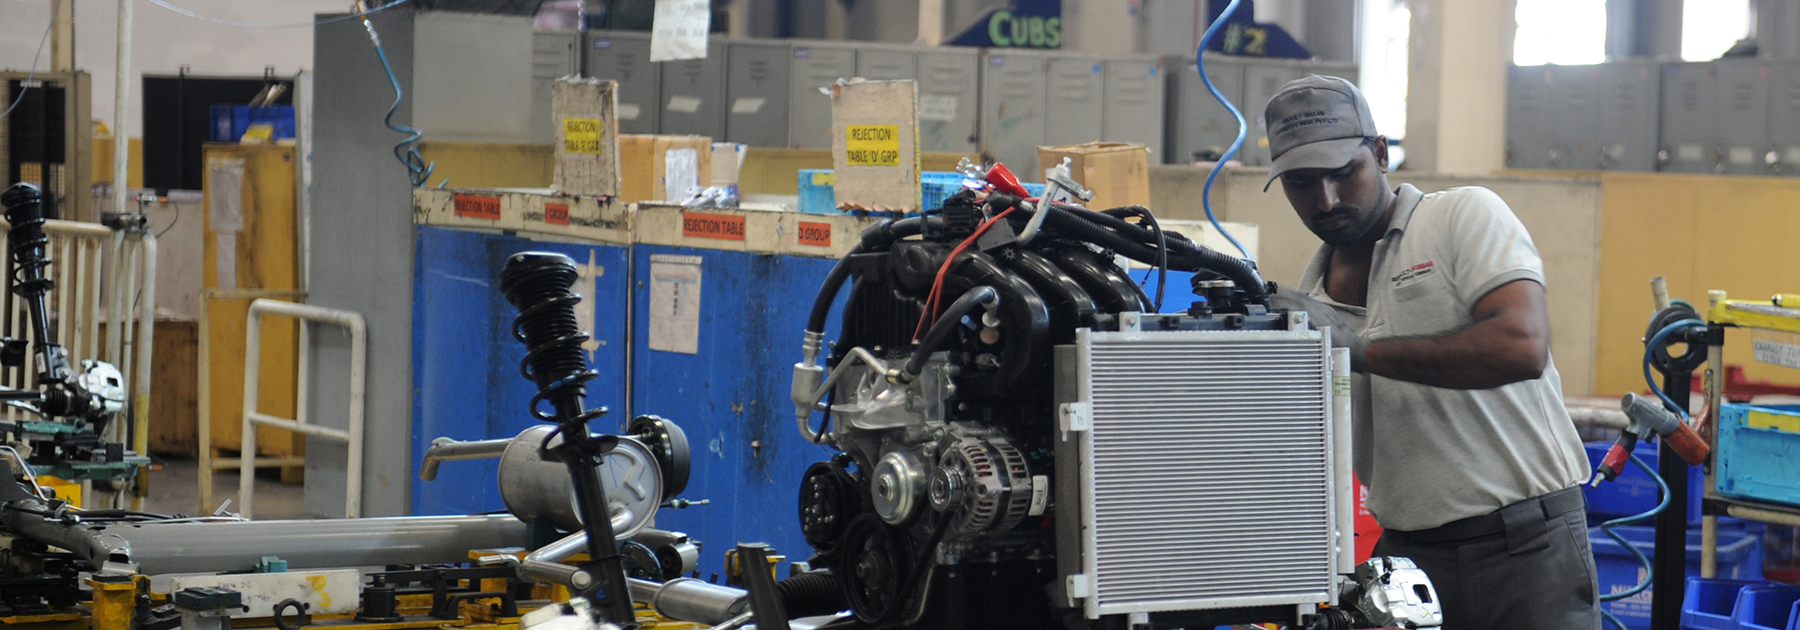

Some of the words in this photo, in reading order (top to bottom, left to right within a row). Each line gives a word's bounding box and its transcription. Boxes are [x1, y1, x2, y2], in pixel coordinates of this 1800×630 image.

[988, 10, 1060, 48] CUBS
[567, 121, 596, 133] REJECTION
[852, 128, 891, 141] REJECTION
[847, 150, 868, 163] TABLE
[881, 150, 898, 163] GRP
[454, 198, 482, 213] REJECTION
[484, 201, 500, 215] TABLE
[549, 207, 568, 220] GROUP
[683, 218, 720, 234] REJECTION
[722, 221, 744, 236] TABLE
[805, 229, 830, 241] GROUP
